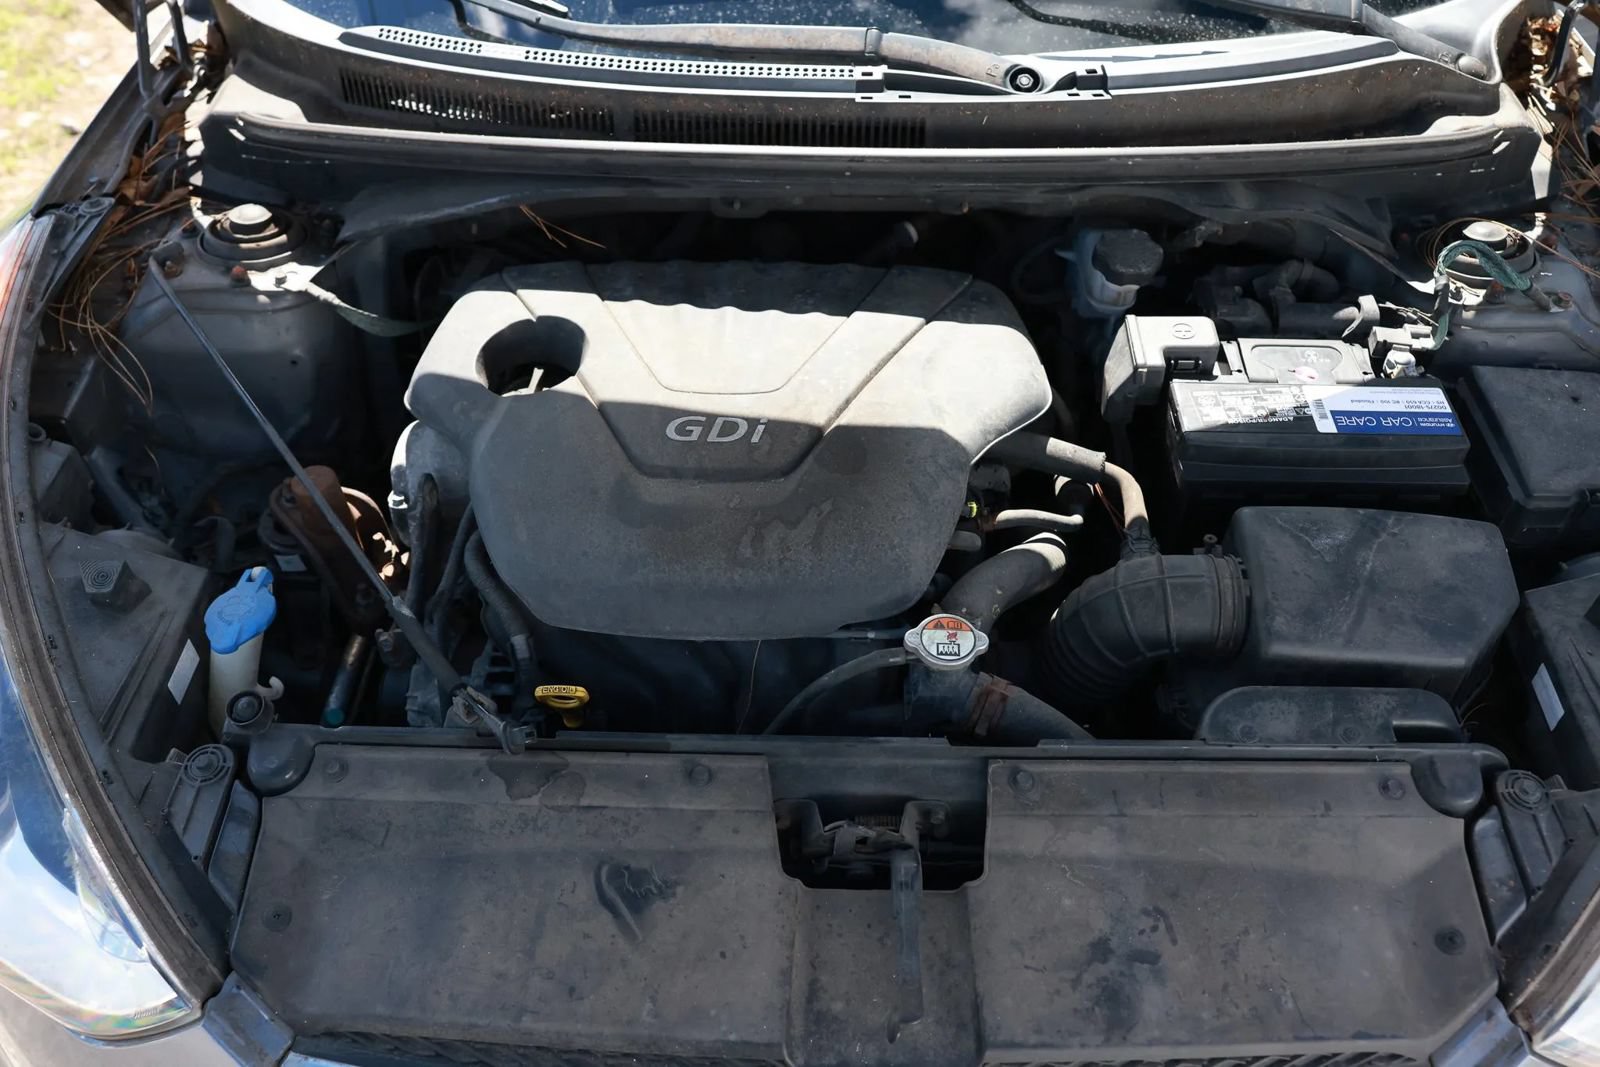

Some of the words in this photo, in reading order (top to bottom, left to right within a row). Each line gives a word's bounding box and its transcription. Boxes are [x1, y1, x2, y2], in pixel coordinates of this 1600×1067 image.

[1334, 415, 1377, 426] CARE
[1380, 416, 1413, 426] CAR
[665, 416, 769, 443] GDi
[561, 686, 576, 694] OIL
